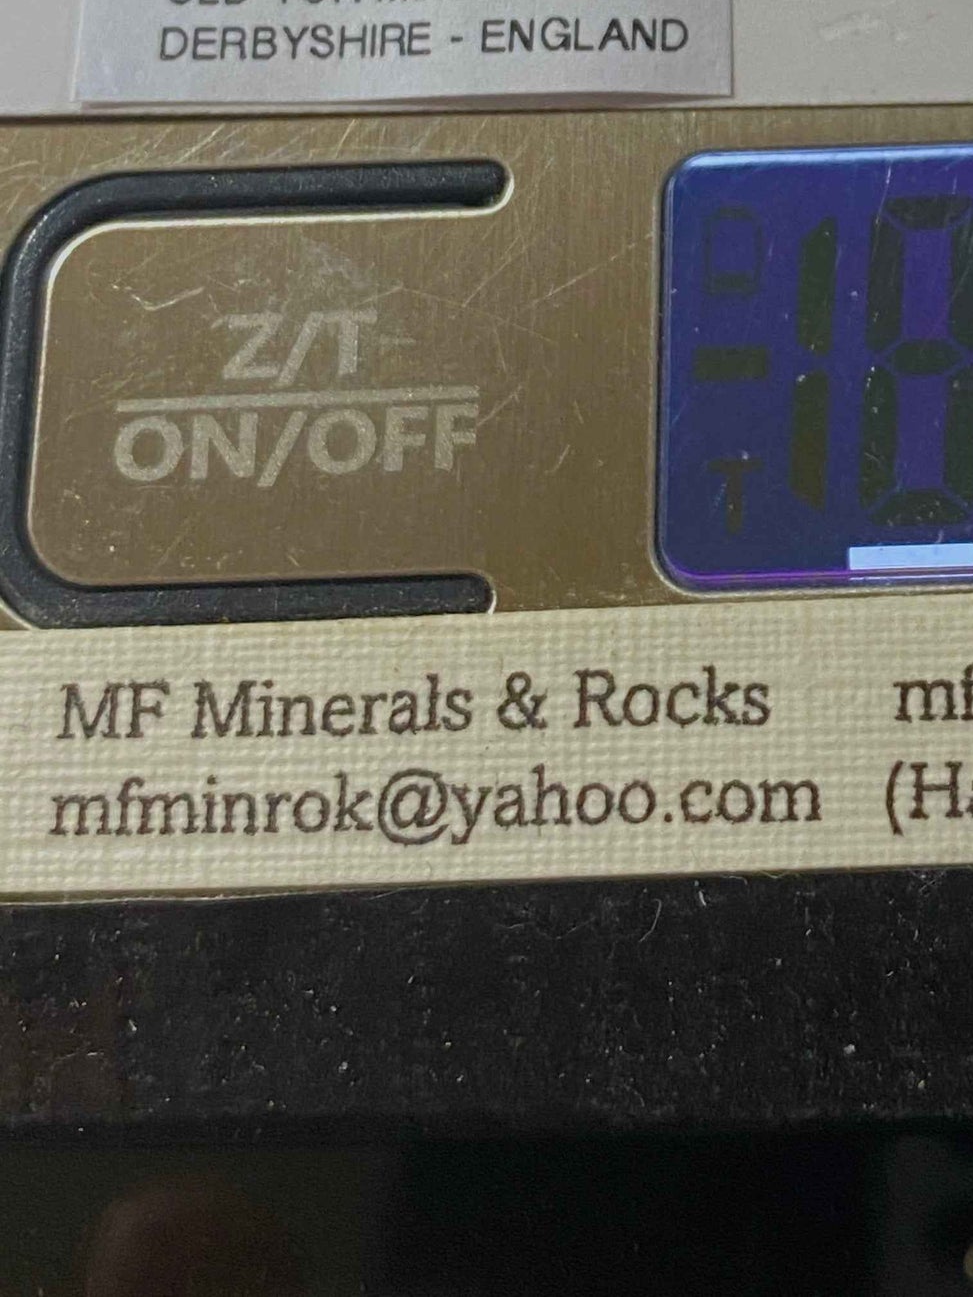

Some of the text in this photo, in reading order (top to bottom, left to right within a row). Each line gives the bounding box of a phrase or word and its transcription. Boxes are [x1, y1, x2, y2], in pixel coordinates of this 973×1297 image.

[160, 22, 432, 62] DERBYSHIRE
[481, 17, 690, 54] ENGLAND
[221, 306, 378, 388] Z/T
[113, 402, 480, 488] ON/OFF
[57, 666, 771, 740] MF Minerals & Rocks
[50, 764, 822, 847] mfminrok@yahoo.com
